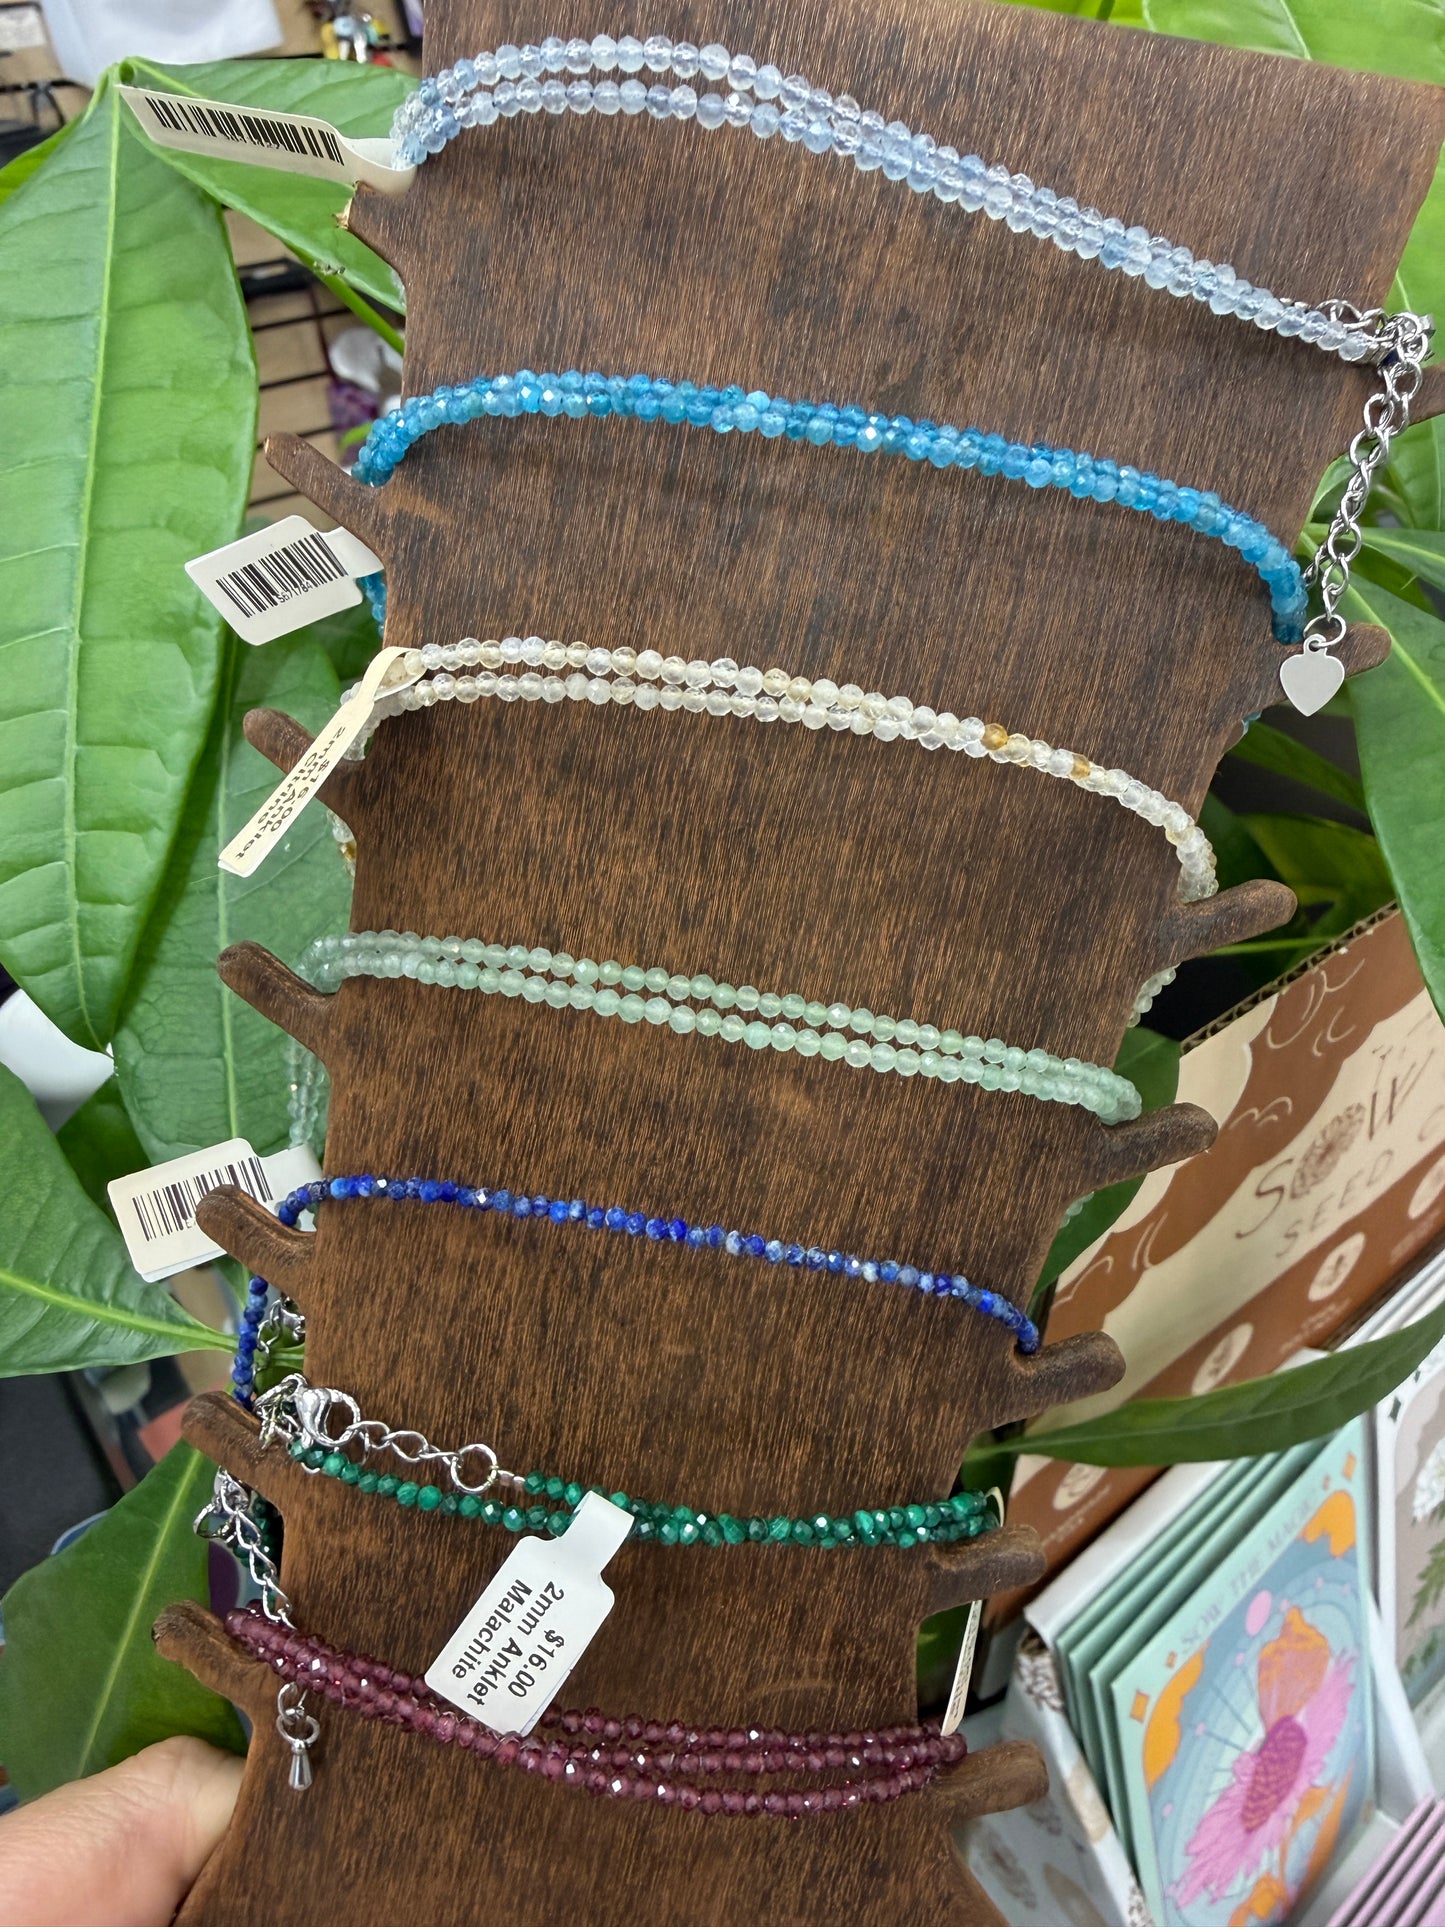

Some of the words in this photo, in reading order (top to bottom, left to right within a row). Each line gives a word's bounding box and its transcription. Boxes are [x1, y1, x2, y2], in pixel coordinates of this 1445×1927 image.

[257, 752, 318, 824] Citrine
[301, 726, 346, 781] 2mm
[235, 788, 296, 860] Anklet
[270, 760, 330, 832] $16.00
[451, 1578, 533, 1679] Malachite
[517, 1580, 565, 1636] 2mm
[466, 1637, 524, 1706] Anklet
[508, 1629, 565, 1698] $16.00
